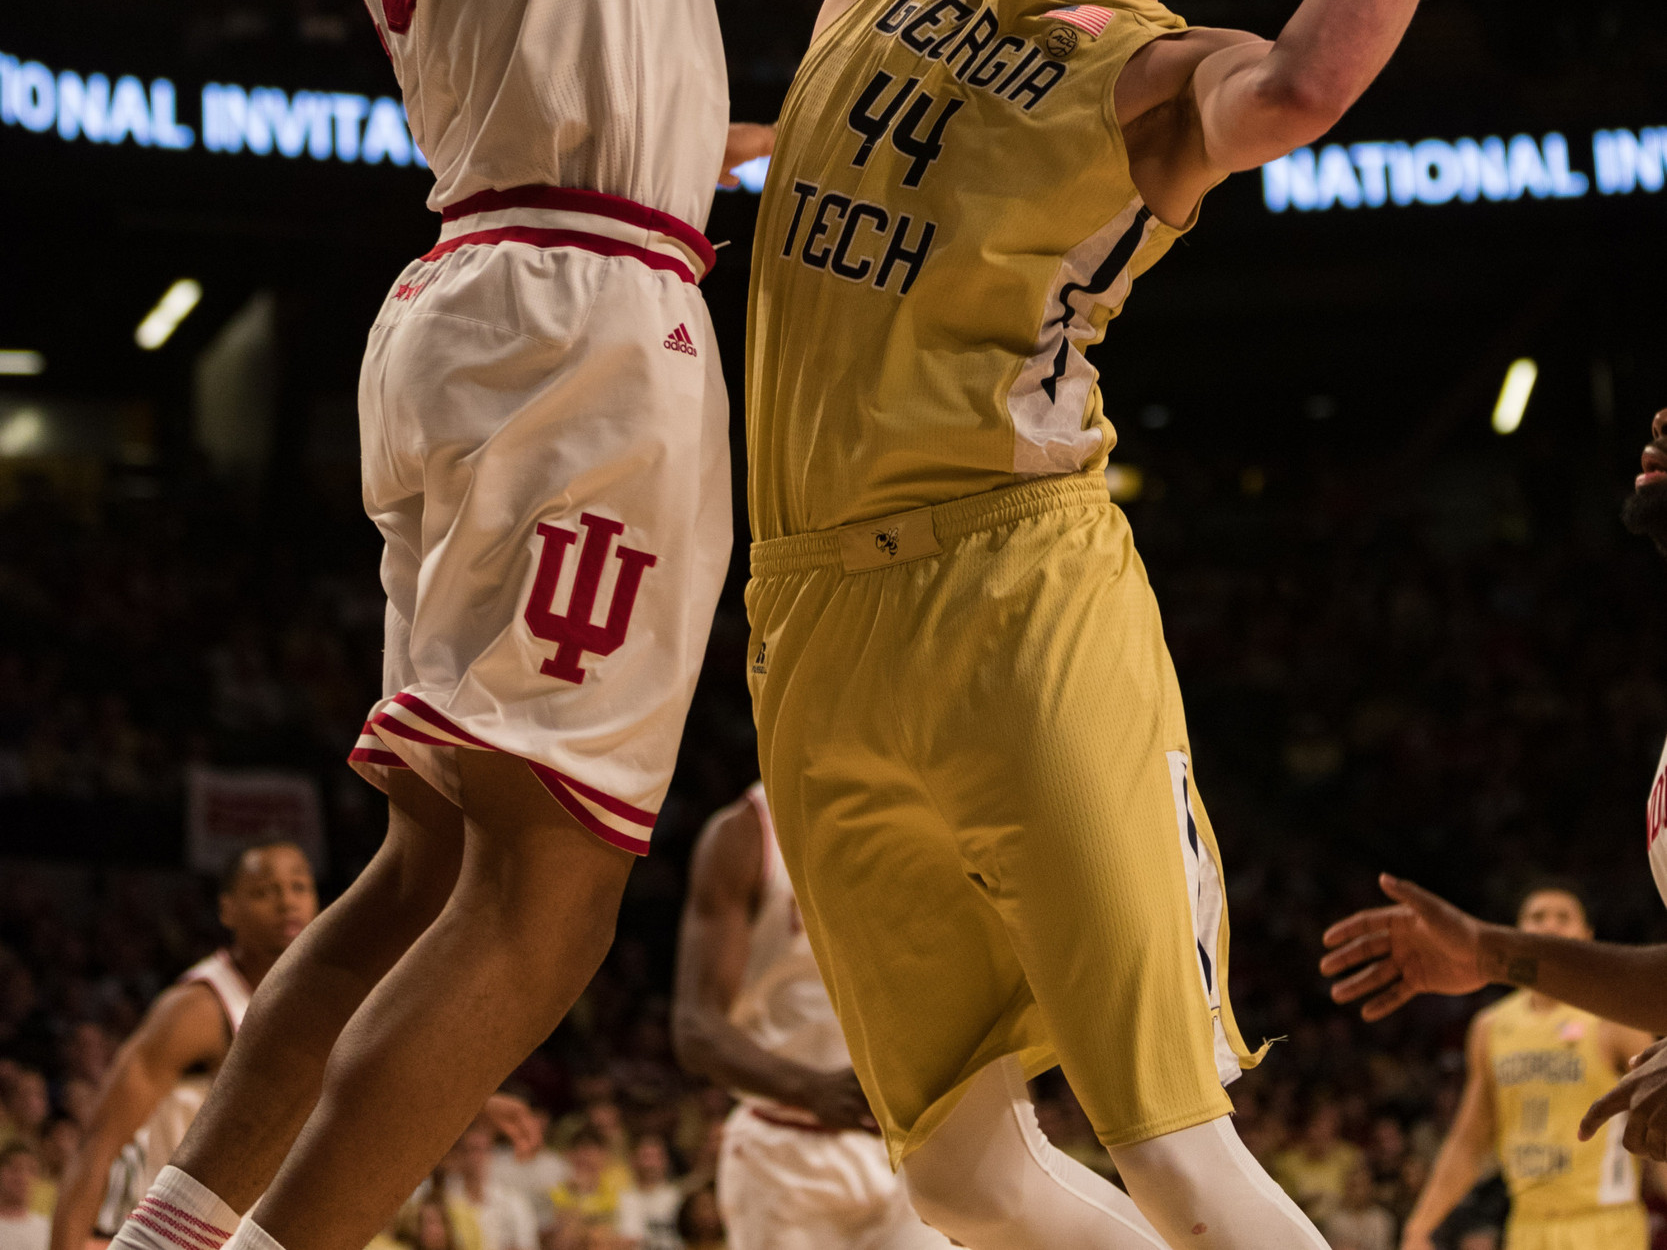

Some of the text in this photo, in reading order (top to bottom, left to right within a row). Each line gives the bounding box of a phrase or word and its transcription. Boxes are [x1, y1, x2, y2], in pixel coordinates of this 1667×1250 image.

[0, 52, 429, 168] IONAL INVITA
[846, 69, 966, 190] 44
[1262, 126, 1667, 213] NATIONAL IN
[779, 179, 939, 297] TECH
[663, 339, 697, 358] adidas
